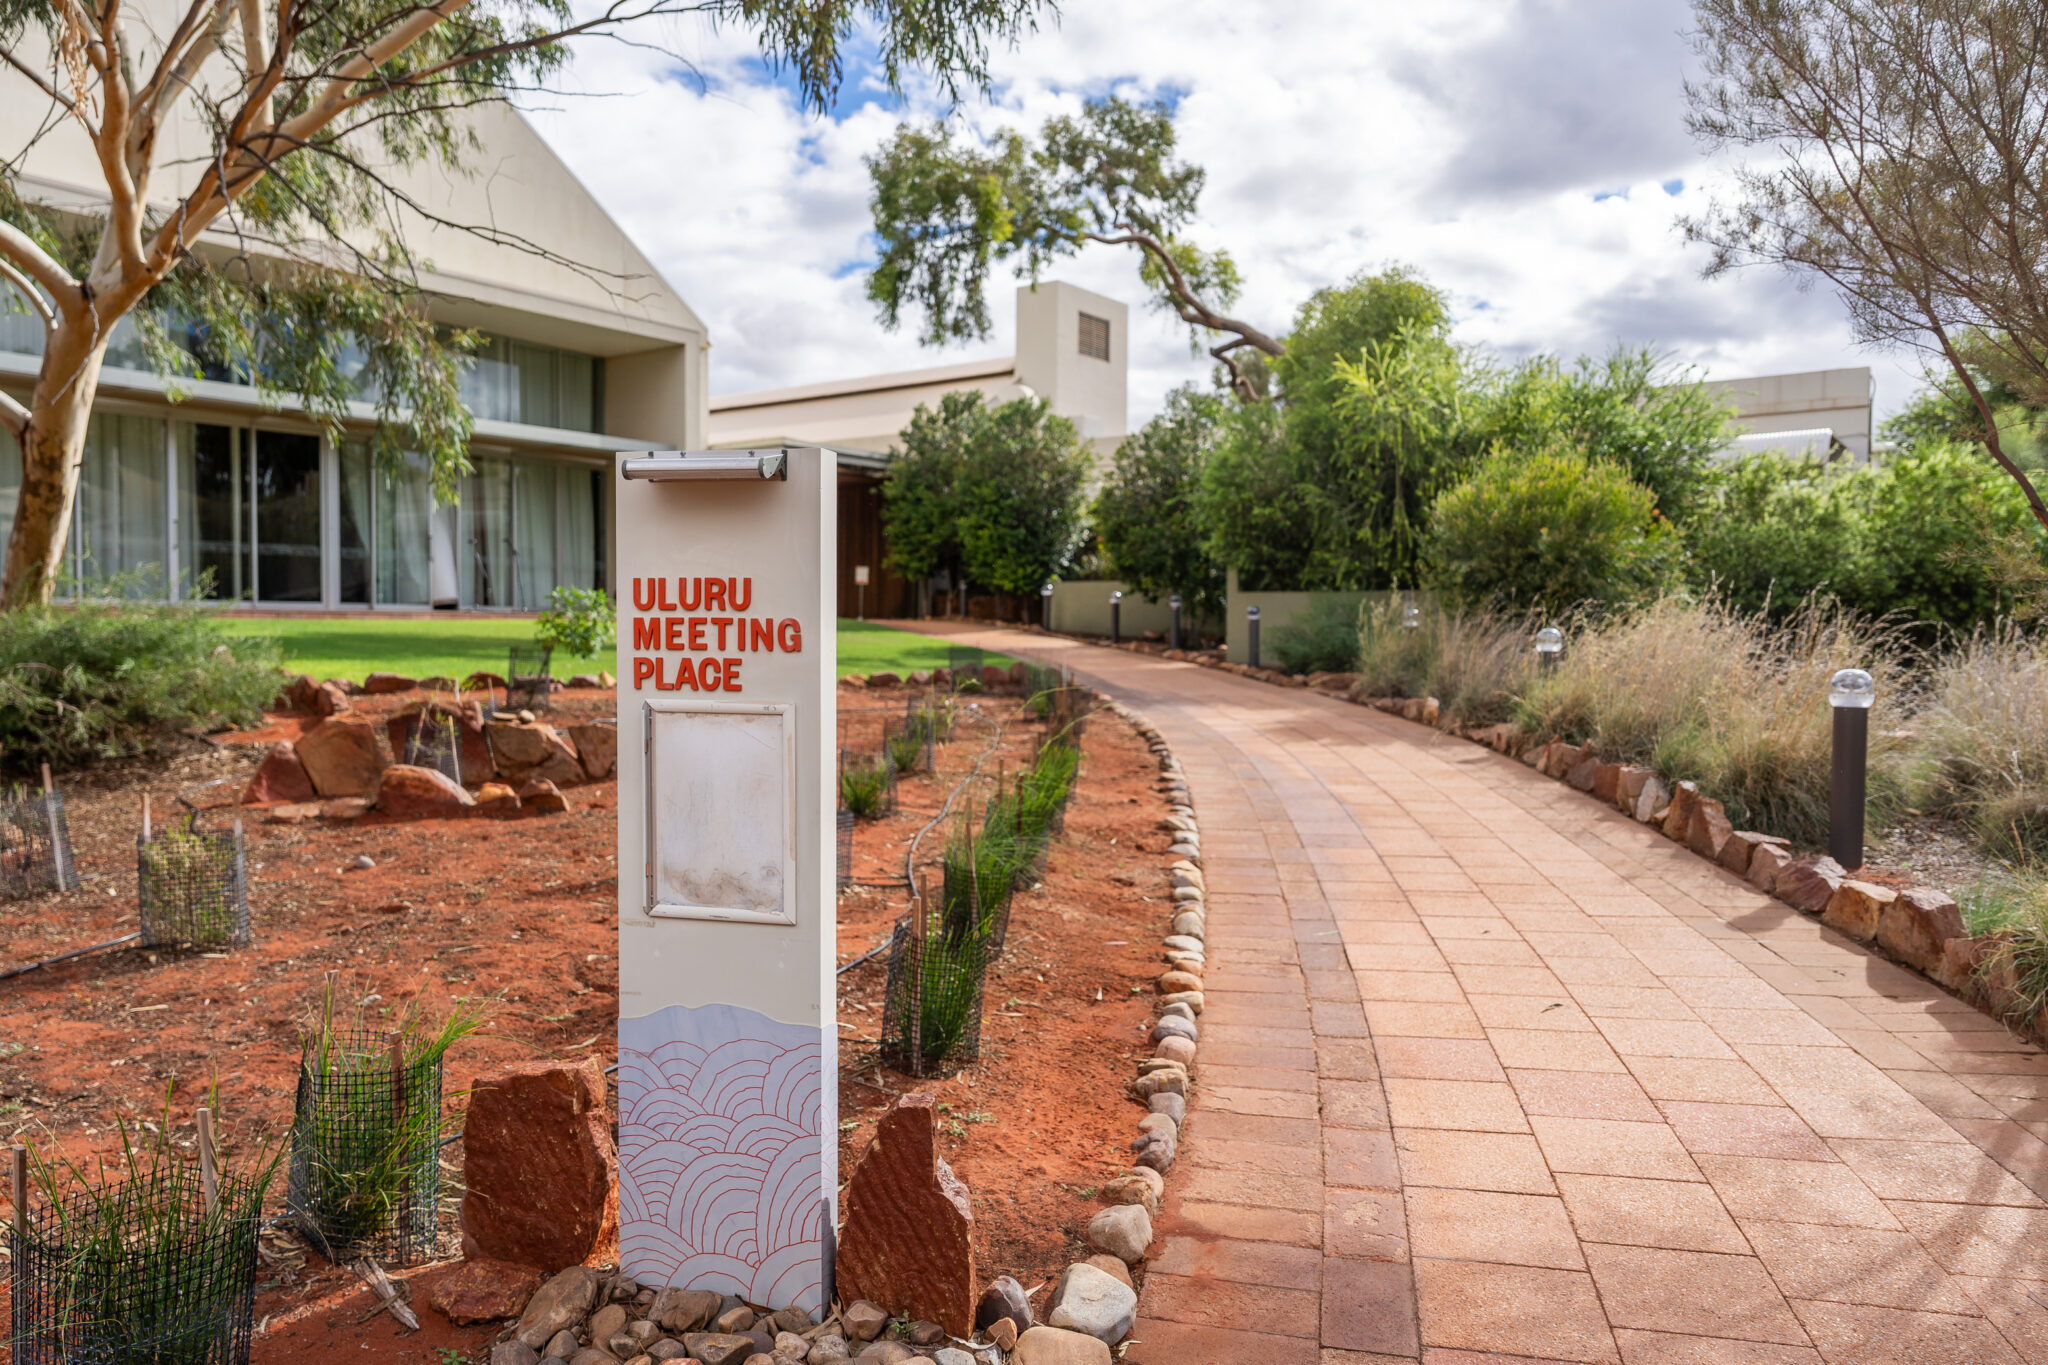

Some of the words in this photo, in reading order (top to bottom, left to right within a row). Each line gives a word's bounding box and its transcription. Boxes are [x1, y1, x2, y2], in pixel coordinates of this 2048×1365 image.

[633, 577, 752, 611] ULURU
[633, 617, 802, 652] MEETING
[633, 657, 743, 692] PLACE
